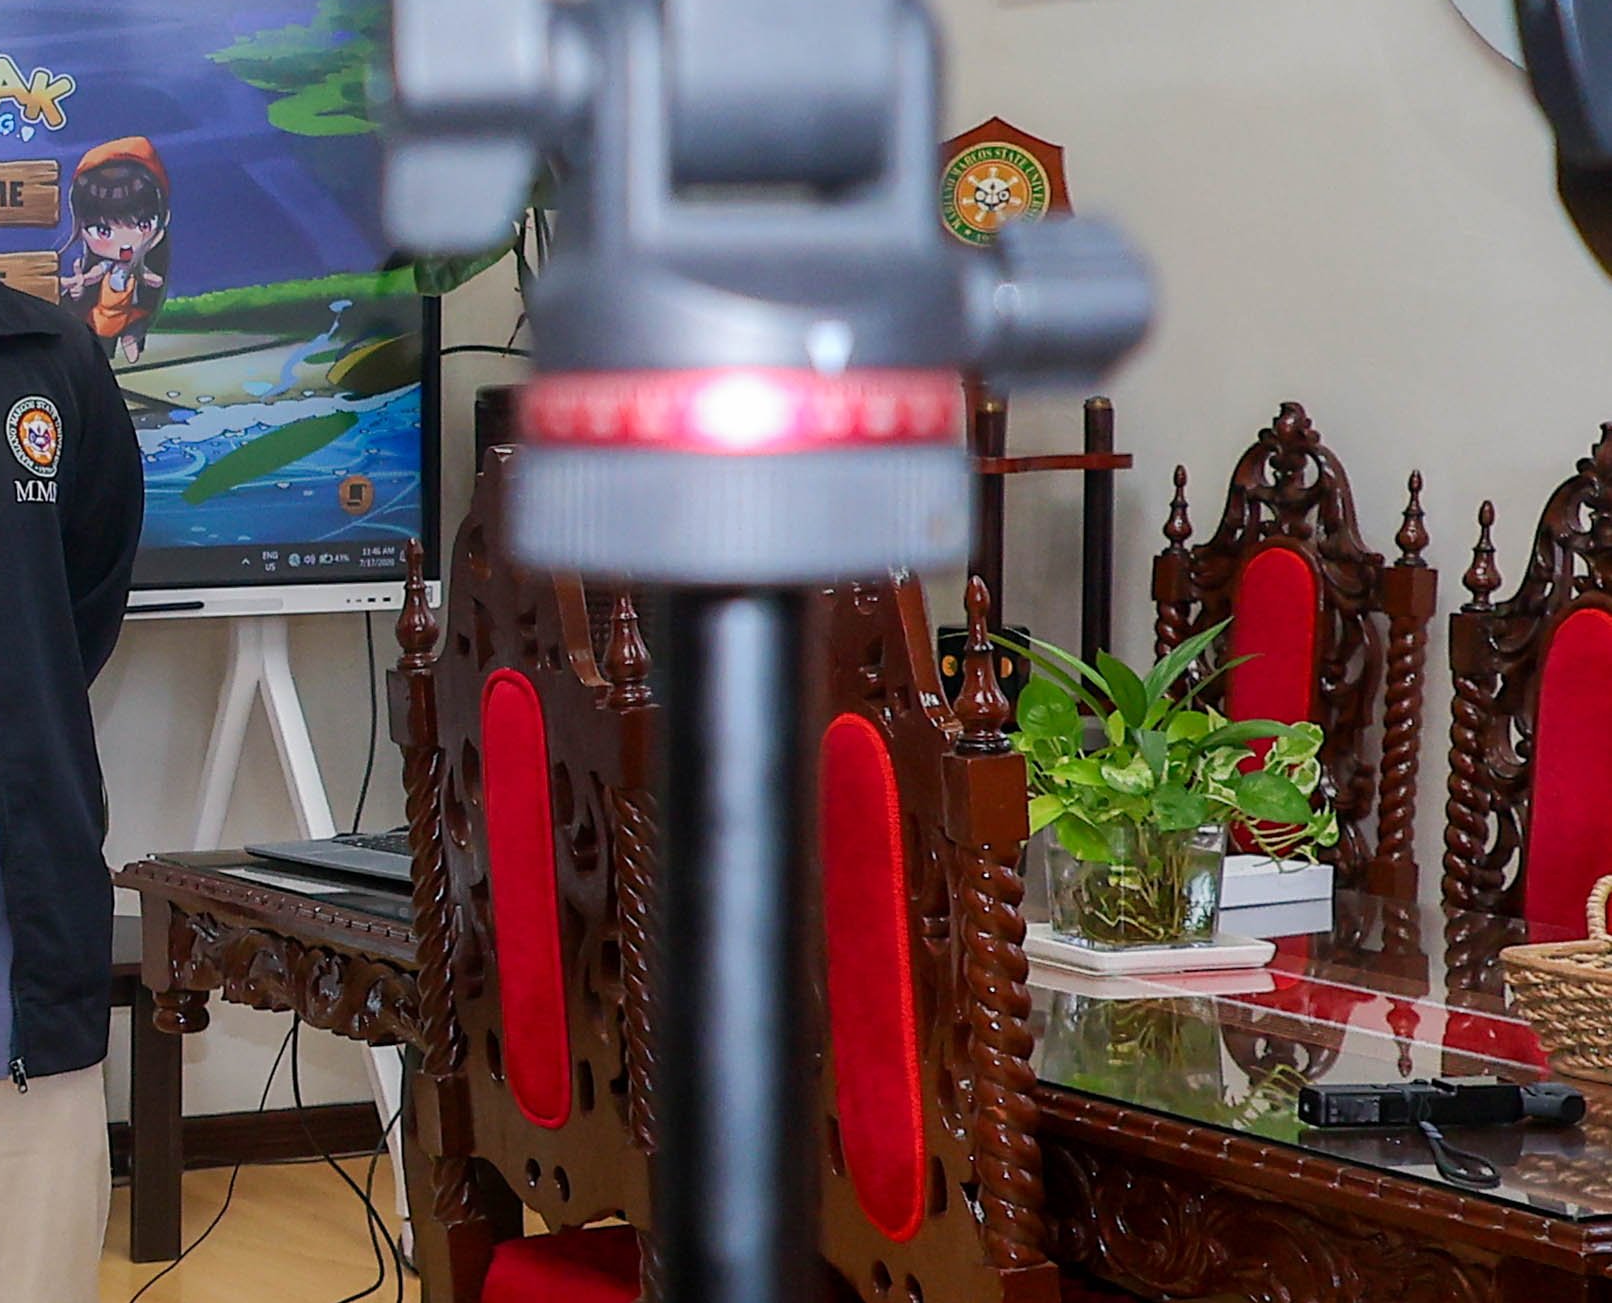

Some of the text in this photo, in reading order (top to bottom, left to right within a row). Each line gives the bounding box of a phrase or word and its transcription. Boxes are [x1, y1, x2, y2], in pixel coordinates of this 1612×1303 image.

[995, 148, 1026, 168] STATE
[382, 546, 395, 555] AM
[262, 551, 279, 560] ENG
[265, 563, 276, 572] US
